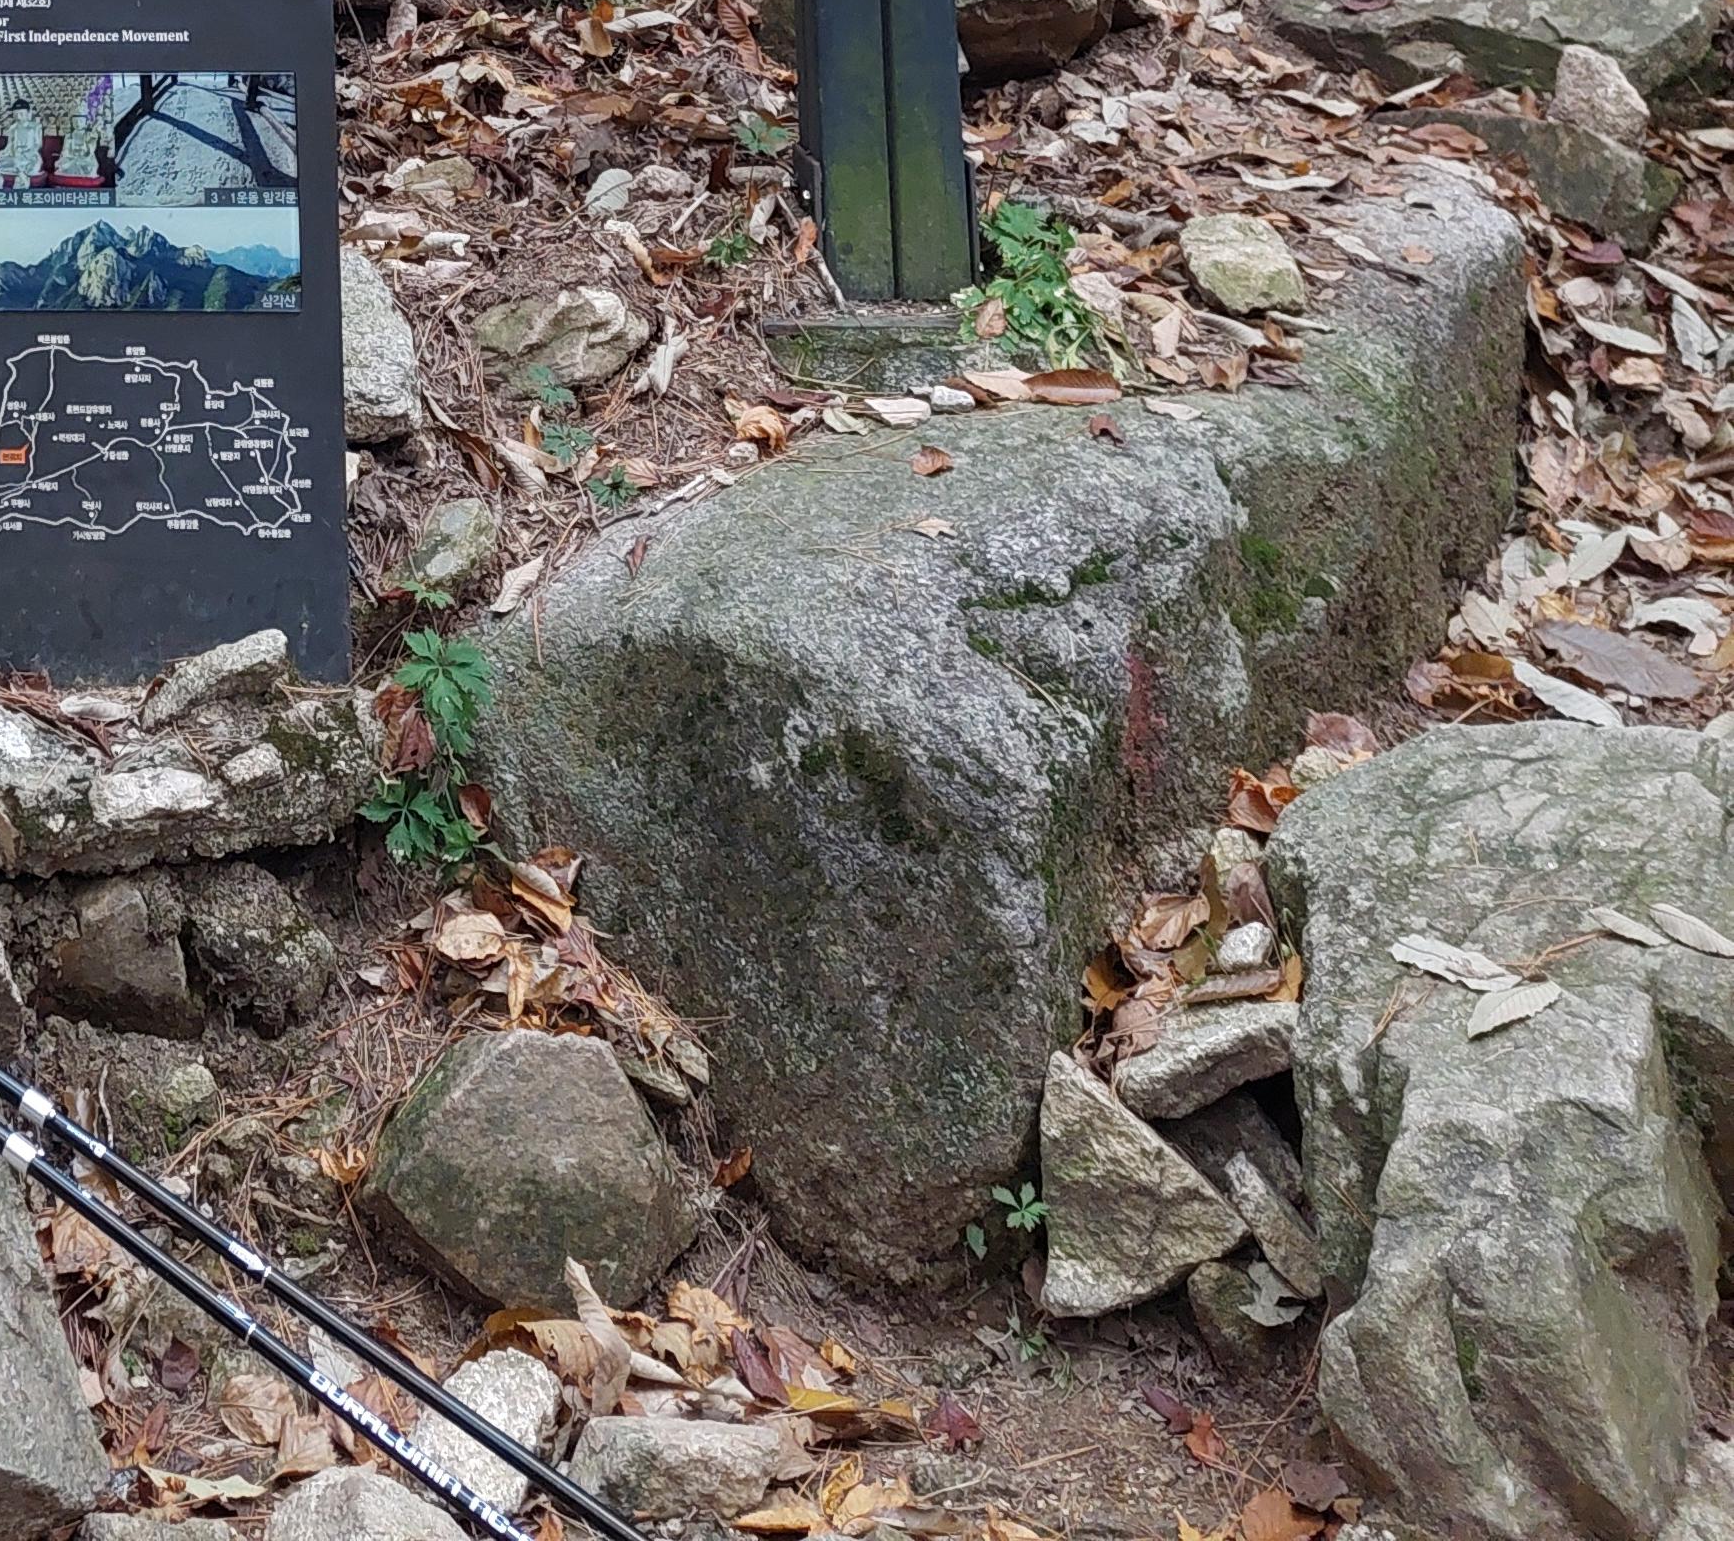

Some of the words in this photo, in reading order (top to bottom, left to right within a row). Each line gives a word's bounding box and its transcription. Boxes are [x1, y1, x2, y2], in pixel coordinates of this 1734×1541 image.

[29, 30, 118, 45] Independence
[122, 30, 189, 42] Movement
[261, 294, 296, 308] 삼각산
